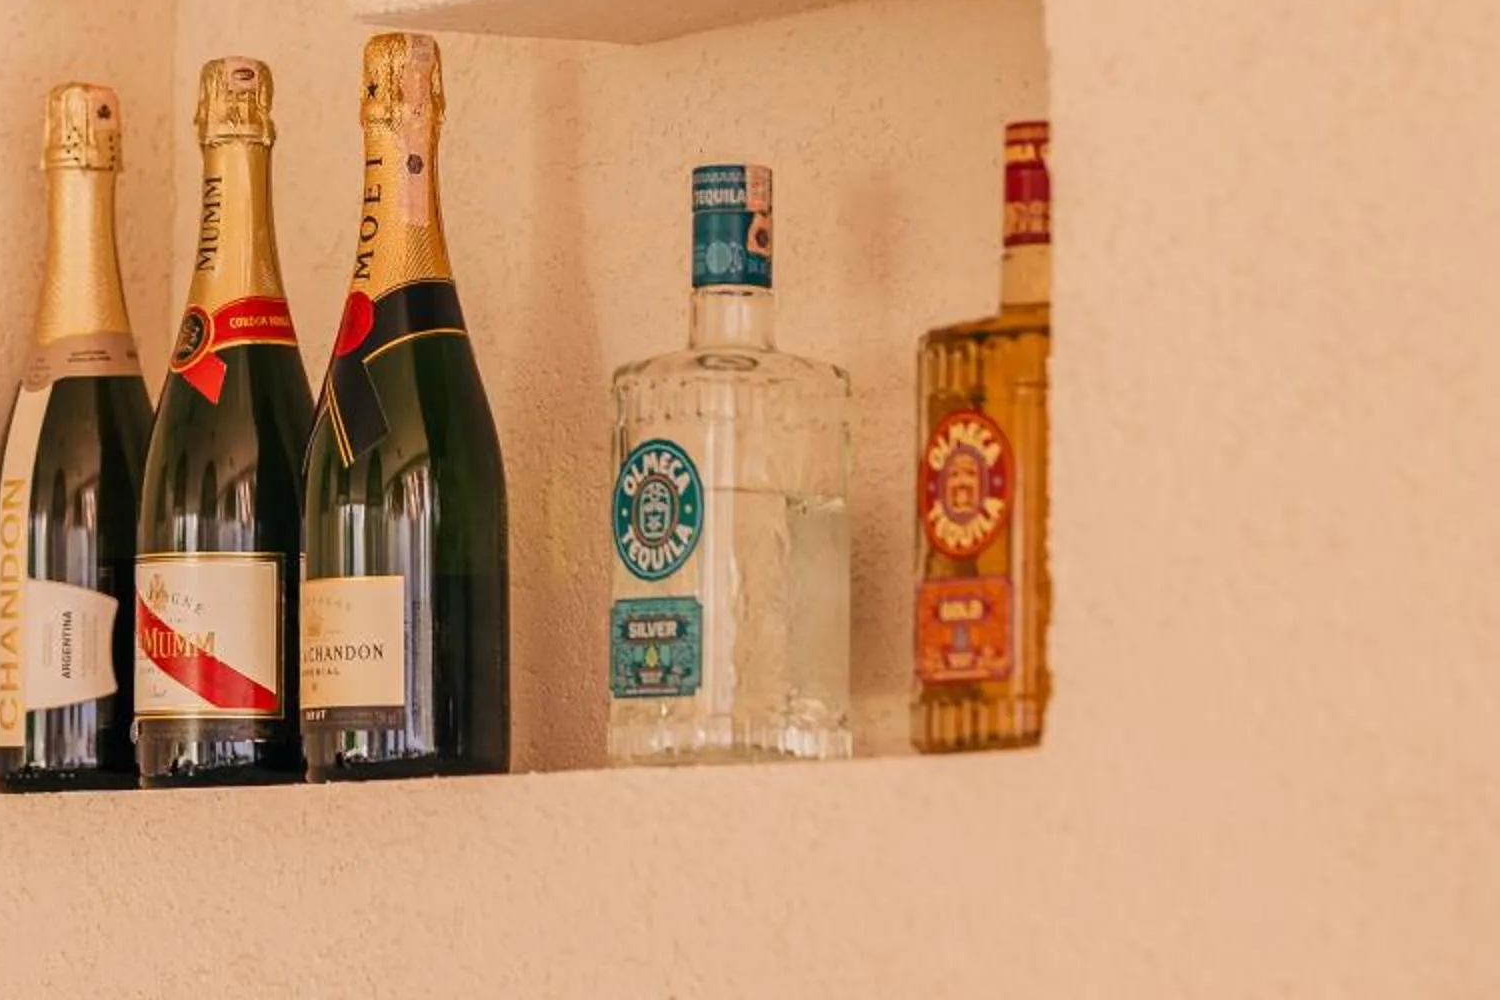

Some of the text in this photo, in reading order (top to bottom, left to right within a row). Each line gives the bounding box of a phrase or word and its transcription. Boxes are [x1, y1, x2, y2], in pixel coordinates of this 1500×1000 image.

[197, 177, 222, 271] MUMM
[623, 451, 691, 497] OLMECA
[620, 524, 693, 571] TEQUILA
[61, 610, 73, 679] ARGENTINA
[143, 626, 216, 659] MUMM
[628, 620, 677, 639] SILVER
